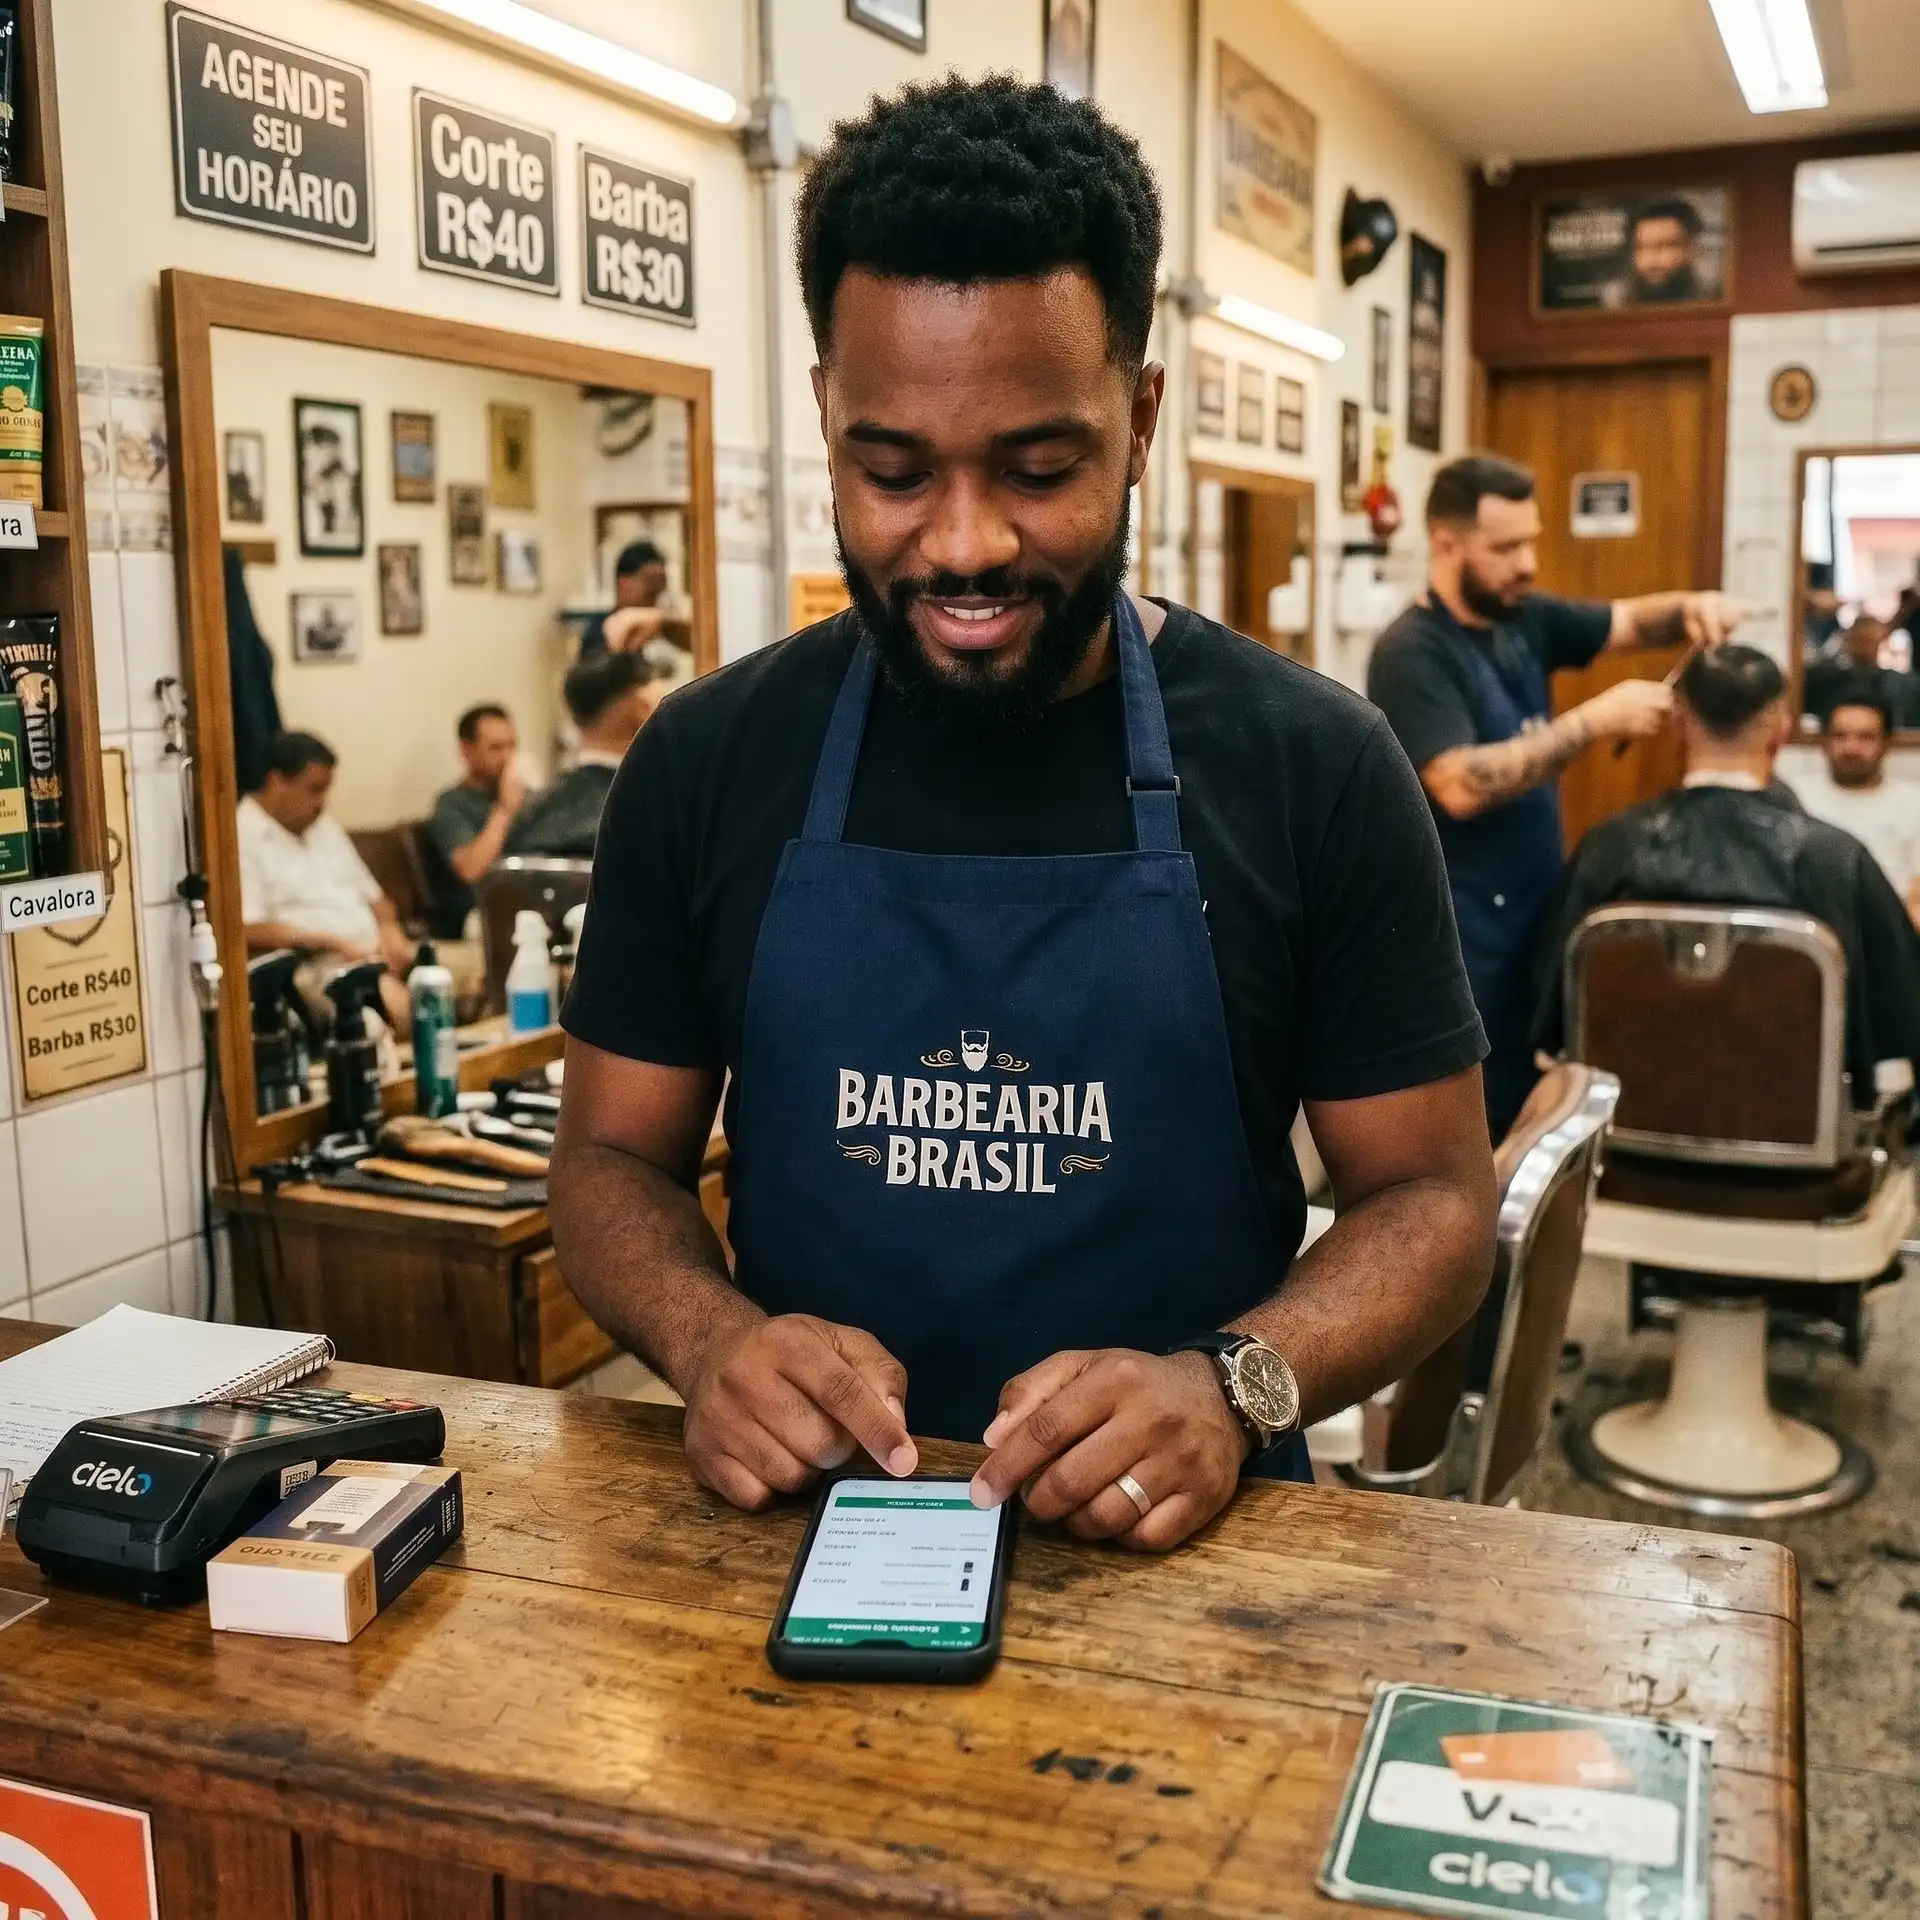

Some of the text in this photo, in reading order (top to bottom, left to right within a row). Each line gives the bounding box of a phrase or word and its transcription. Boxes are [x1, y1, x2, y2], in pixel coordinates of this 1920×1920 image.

[201, 41, 347, 128] AGENDE
[252, 112, 303, 157] SEU
[430, 113, 545, 203] Corte
[197, 146, 358, 229] HORÁRIO
[587, 161, 688, 247] Barba
[436, 190, 546, 276] R$40
[596, 233, 685, 310] R$30
[9, 889, 96, 918] Cavalora
[26, 966, 133, 1007] Corte R$40
[27, 1014, 137, 1058] Barba R$30
[836, 1067, 1113, 1143] BARBEARIA
[886, 1134, 1056, 1194] BRASIL
[71, 1460, 152, 1496] cielo
[1429, 1850, 1601, 1903] cielo
